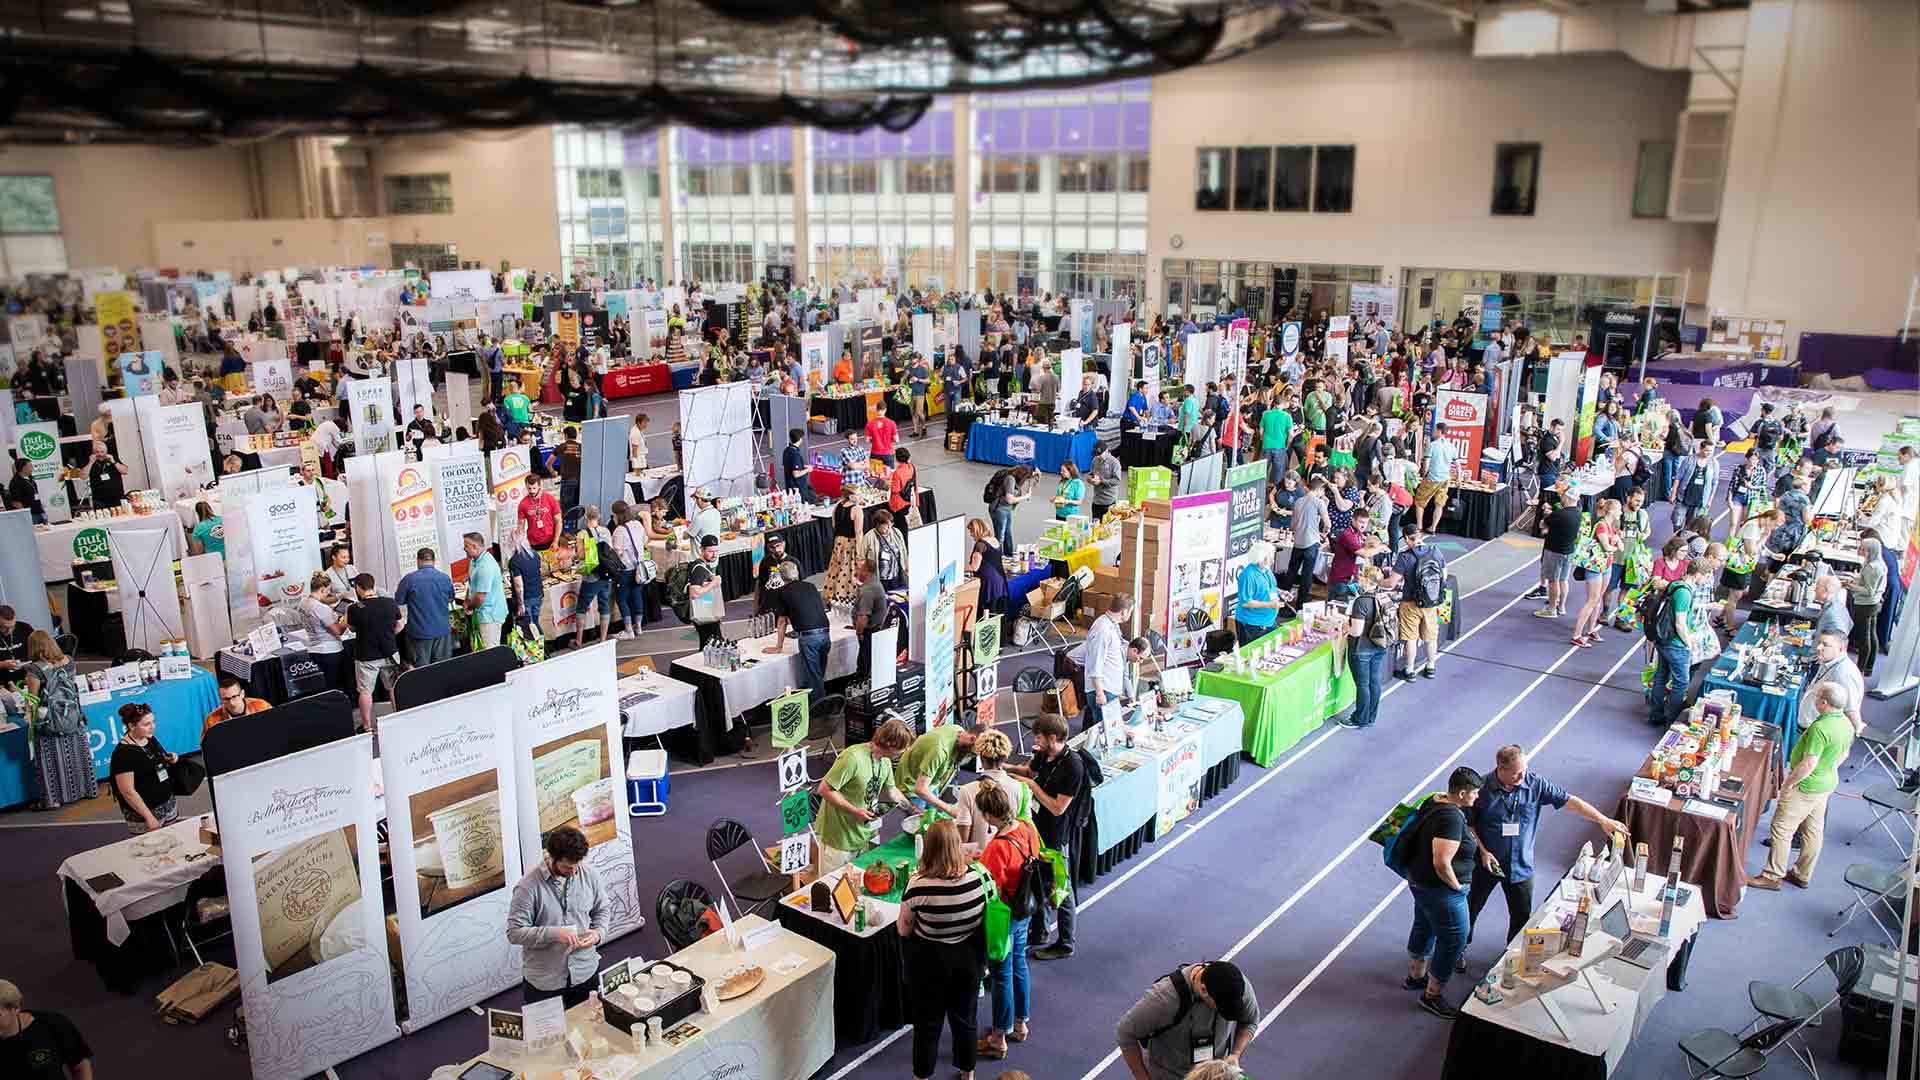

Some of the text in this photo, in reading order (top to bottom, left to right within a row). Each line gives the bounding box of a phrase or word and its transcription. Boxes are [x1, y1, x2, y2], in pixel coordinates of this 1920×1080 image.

[263, 376, 286, 388] suja
[1448, 410, 1473, 418] DIRECT
[23, 435, 43, 445] nut
[24, 439, 54, 455] pods
[444, 482, 484, 497] PALEO
[444, 493, 485, 504] COCONUT
[446, 500, 486, 512] GRANOLA
[268, 500, 297, 516] good
[1233, 498, 1261, 520] STICKS
[77, 533, 103, 546] nut
[78, 537, 108, 560] pod
[543, 769, 577, 791] ORGANIC
[314, 784, 353, 801] Farms
[711, 1063, 744, 1080] Farms
